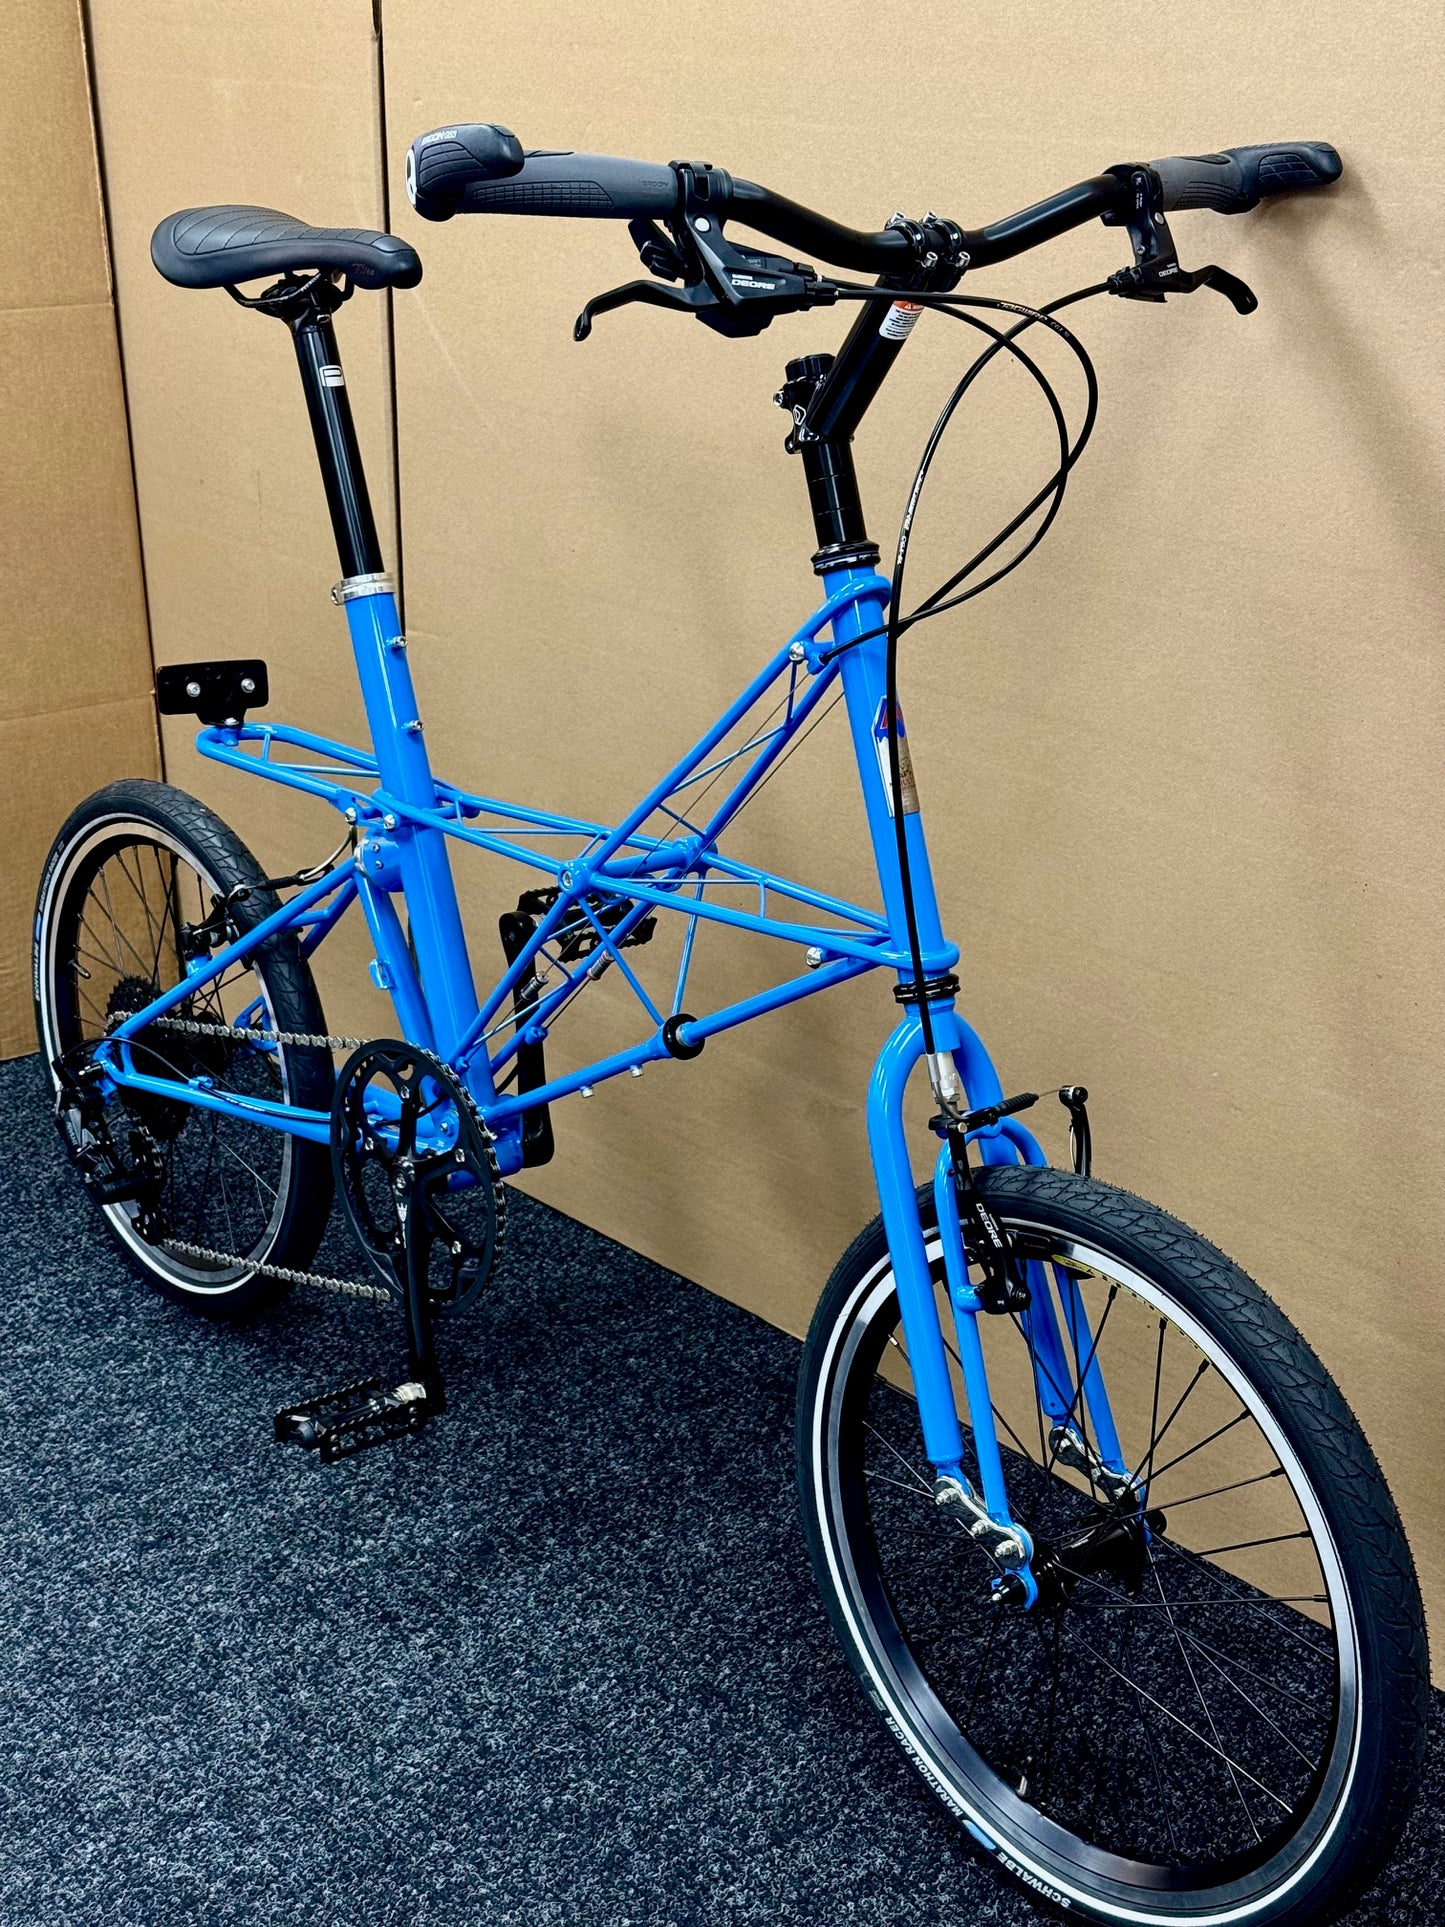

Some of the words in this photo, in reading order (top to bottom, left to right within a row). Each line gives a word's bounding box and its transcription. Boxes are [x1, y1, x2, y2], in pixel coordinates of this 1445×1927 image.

[731, 279, 776, 291] DEORE
[1158, 267, 1178, 277] DEORE
[976, 1203, 1003, 1248] DEORE
[885, 1717, 915, 1755] RACER
[911, 1757, 963, 1817] MARATHON
[996, 1852, 1071, 1908] SCHWALBE
